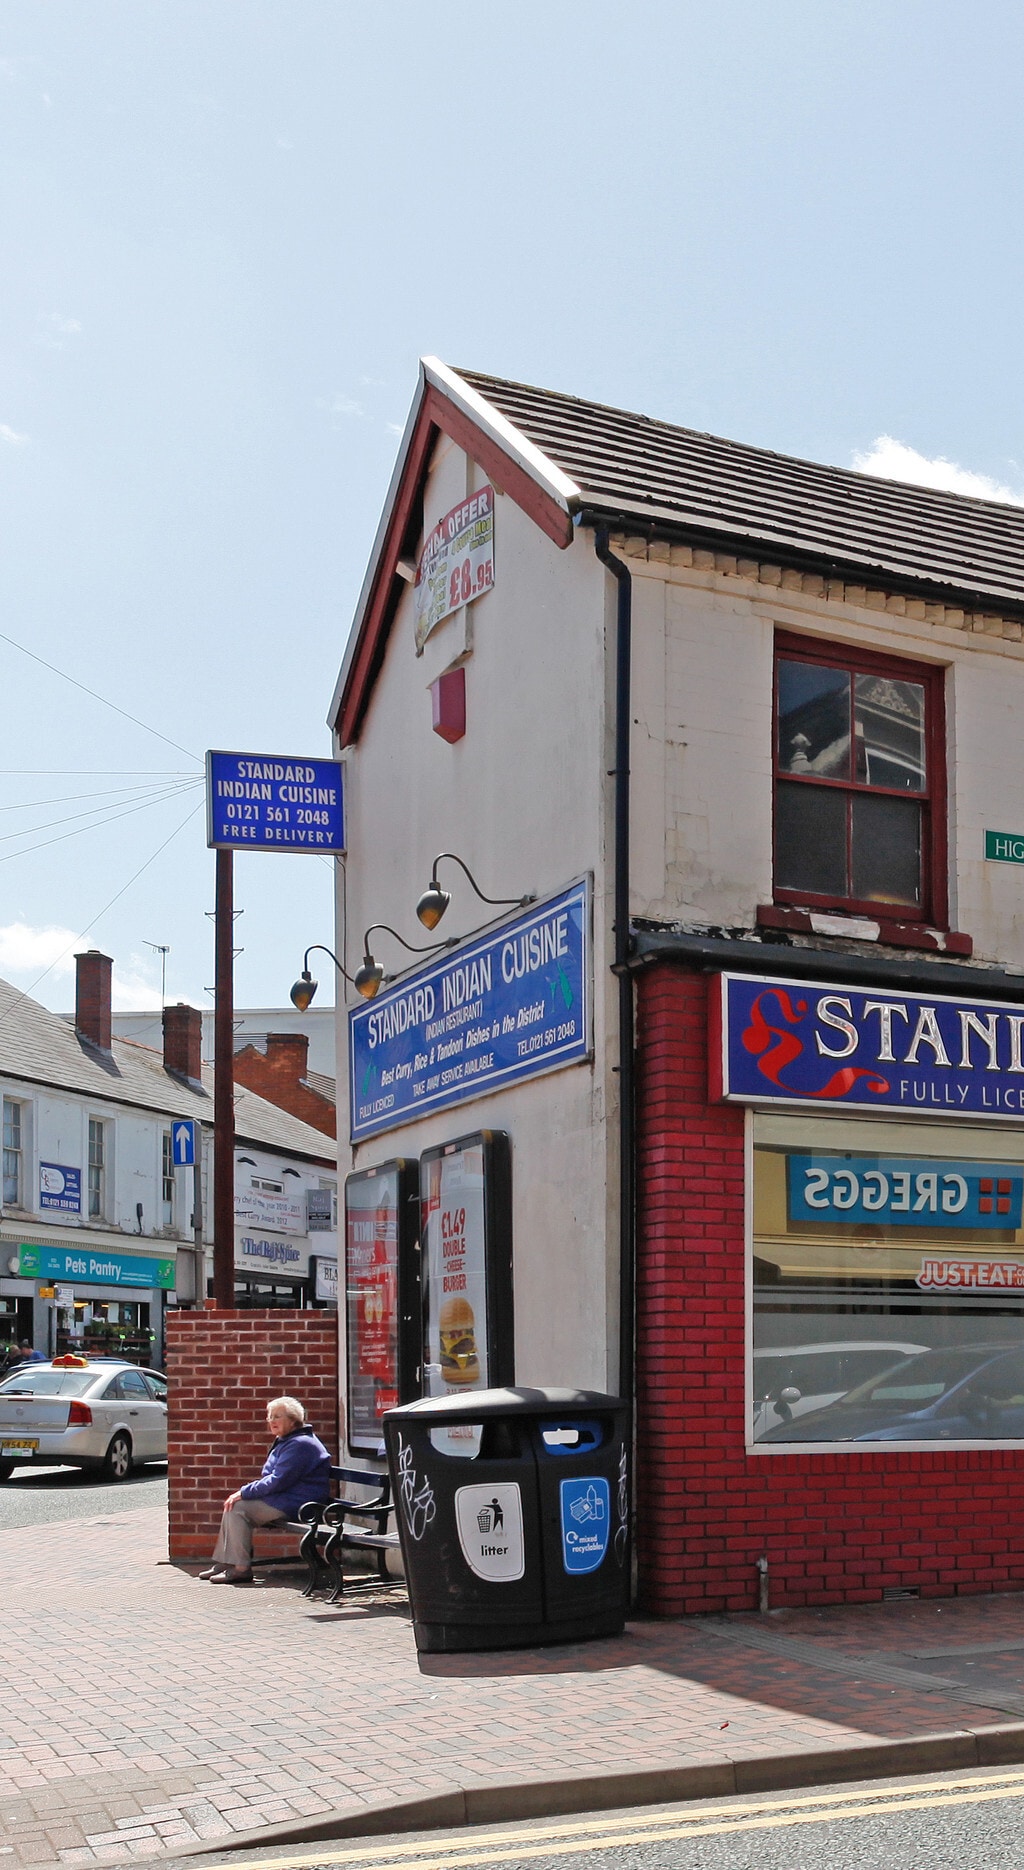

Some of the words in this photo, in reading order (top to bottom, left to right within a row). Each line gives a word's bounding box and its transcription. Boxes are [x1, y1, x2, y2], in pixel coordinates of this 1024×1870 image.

[448, 493, 489, 538] OFFER
[450, 558, 492, 608] £8.95
[238, 761, 315, 783] STANDARD
[218, 780, 271, 801] INDIAN
[279, 785, 337, 806] CUISINE
[227, 804, 259, 820] 0121
[267, 807, 289, 823] 561
[297, 809, 329, 825] 2048
[223, 824, 257, 838] FREE
[265, 827, 334, 844] DELIVERY
[368, 984, 435, 1049] STANDARD
[442, 954, 492, 1013] INDIAN
[502, 913, 568, 984] CUISINE
[381, 1066, 395, 1087] Best
[414, 1051, 428, 1072] Rice
[429, 1047, 435, 1065] &
[437, 1032, 464, 1062] Tandoori
[466, 1026, 490, 1049] Dishes
[492, 1019, 500, 1039] in
[502, 1014, 515, 1035] the
[516, 1000, 545, 1029] District
[544, 1027, 556, 1046] 561
[557, 1019, 576, 1041] 2048
[412, 1080, 426, 1097] TAKE
[441, 1063, 463, 1086] SERVICE
[464, 1052, 494, 1077] AVAILABLE
[900, 1080, 970, 1105] FULLY
[442, 1207, 466, 1238] £1.49
[443, 1238, 465, 1258] DOUBLE
[65, 1256, 86, 1274] Pets
[90, 1259, 121, 1281] Pantry
[443, 1274, 467, 1292] BURGER
[481, 1545, 508, 1556] litter
[572, 1542, 604, 1554] recyclables
[579, 1534, 598, 1543] mixed
